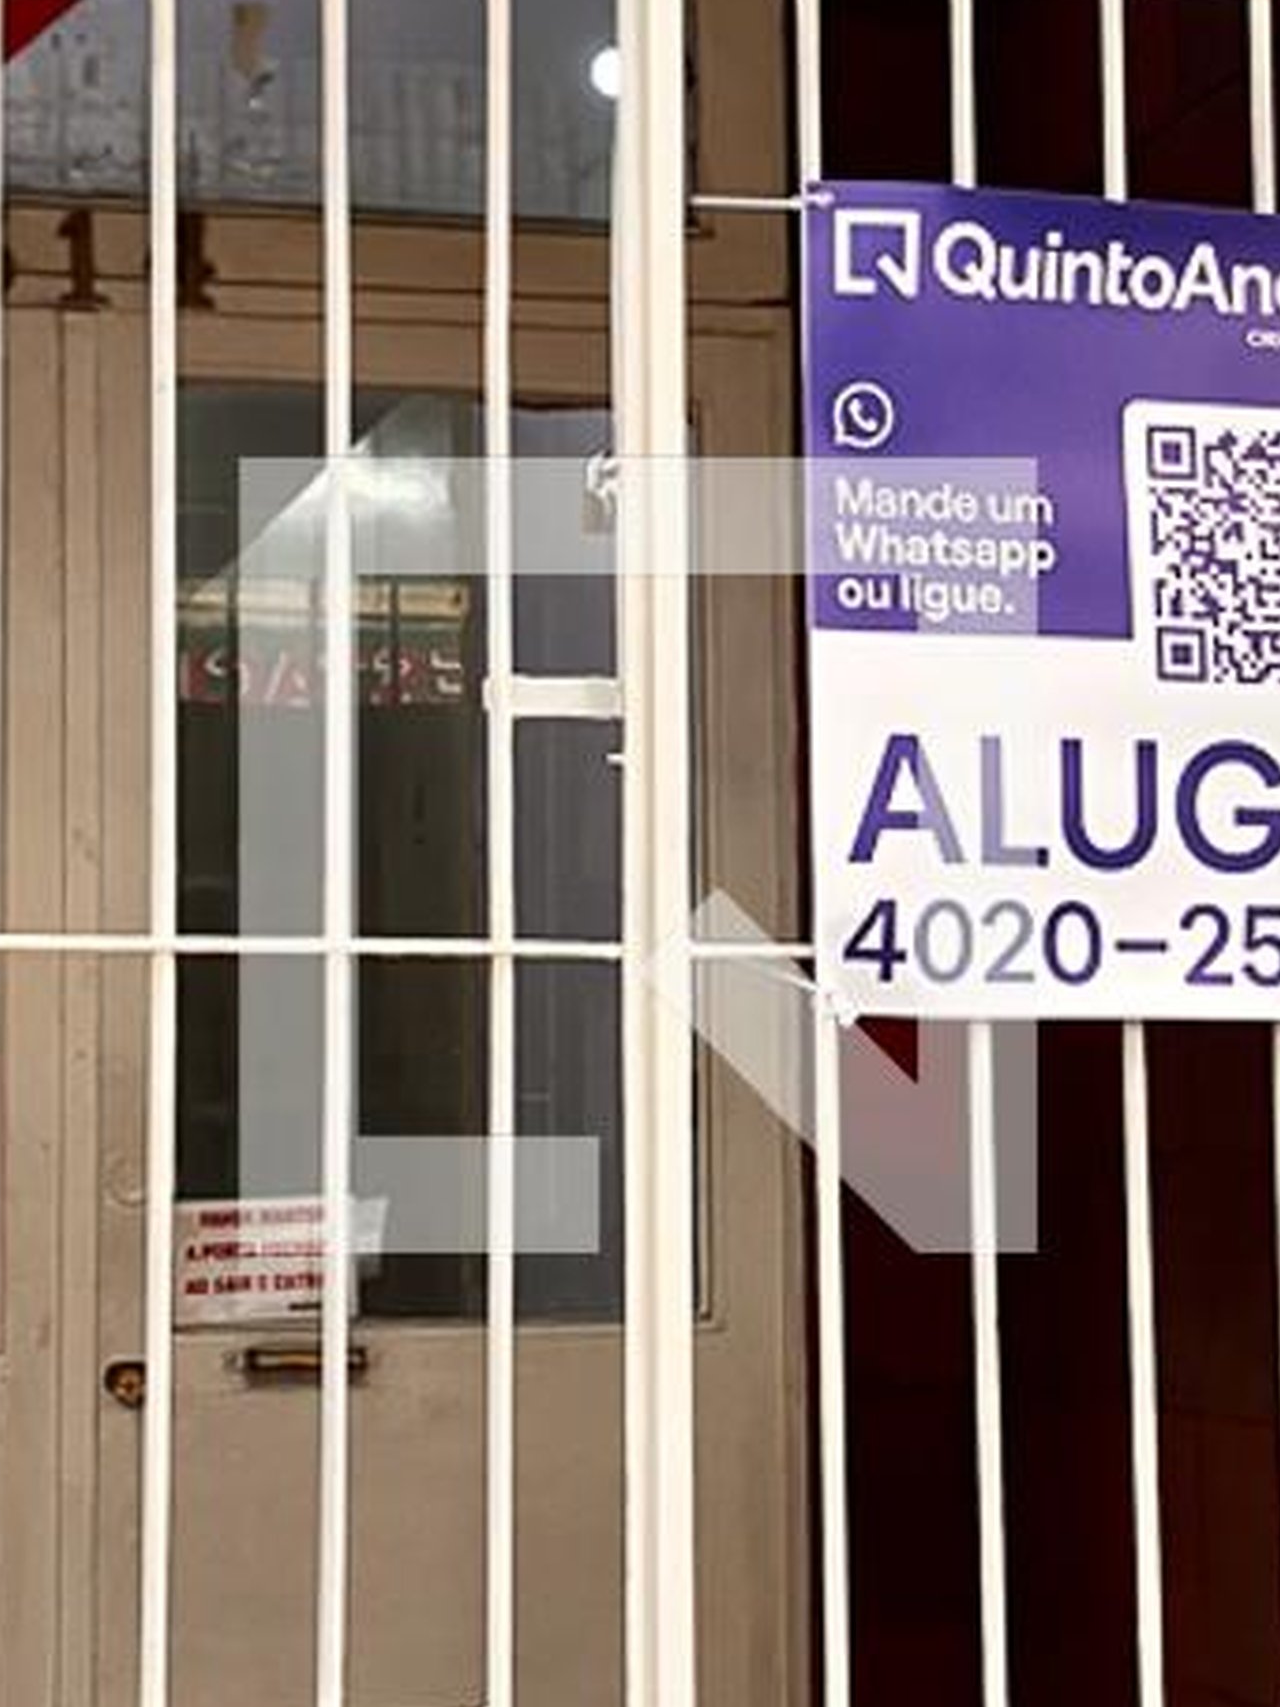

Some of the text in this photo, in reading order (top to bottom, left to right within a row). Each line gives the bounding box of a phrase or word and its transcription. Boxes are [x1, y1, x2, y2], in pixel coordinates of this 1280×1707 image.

[835, 476, 1055, 525] Mande um
[834, 521, 1057, 580] Whatsapp
[837, 572, 1015, 623] ou ligue.
